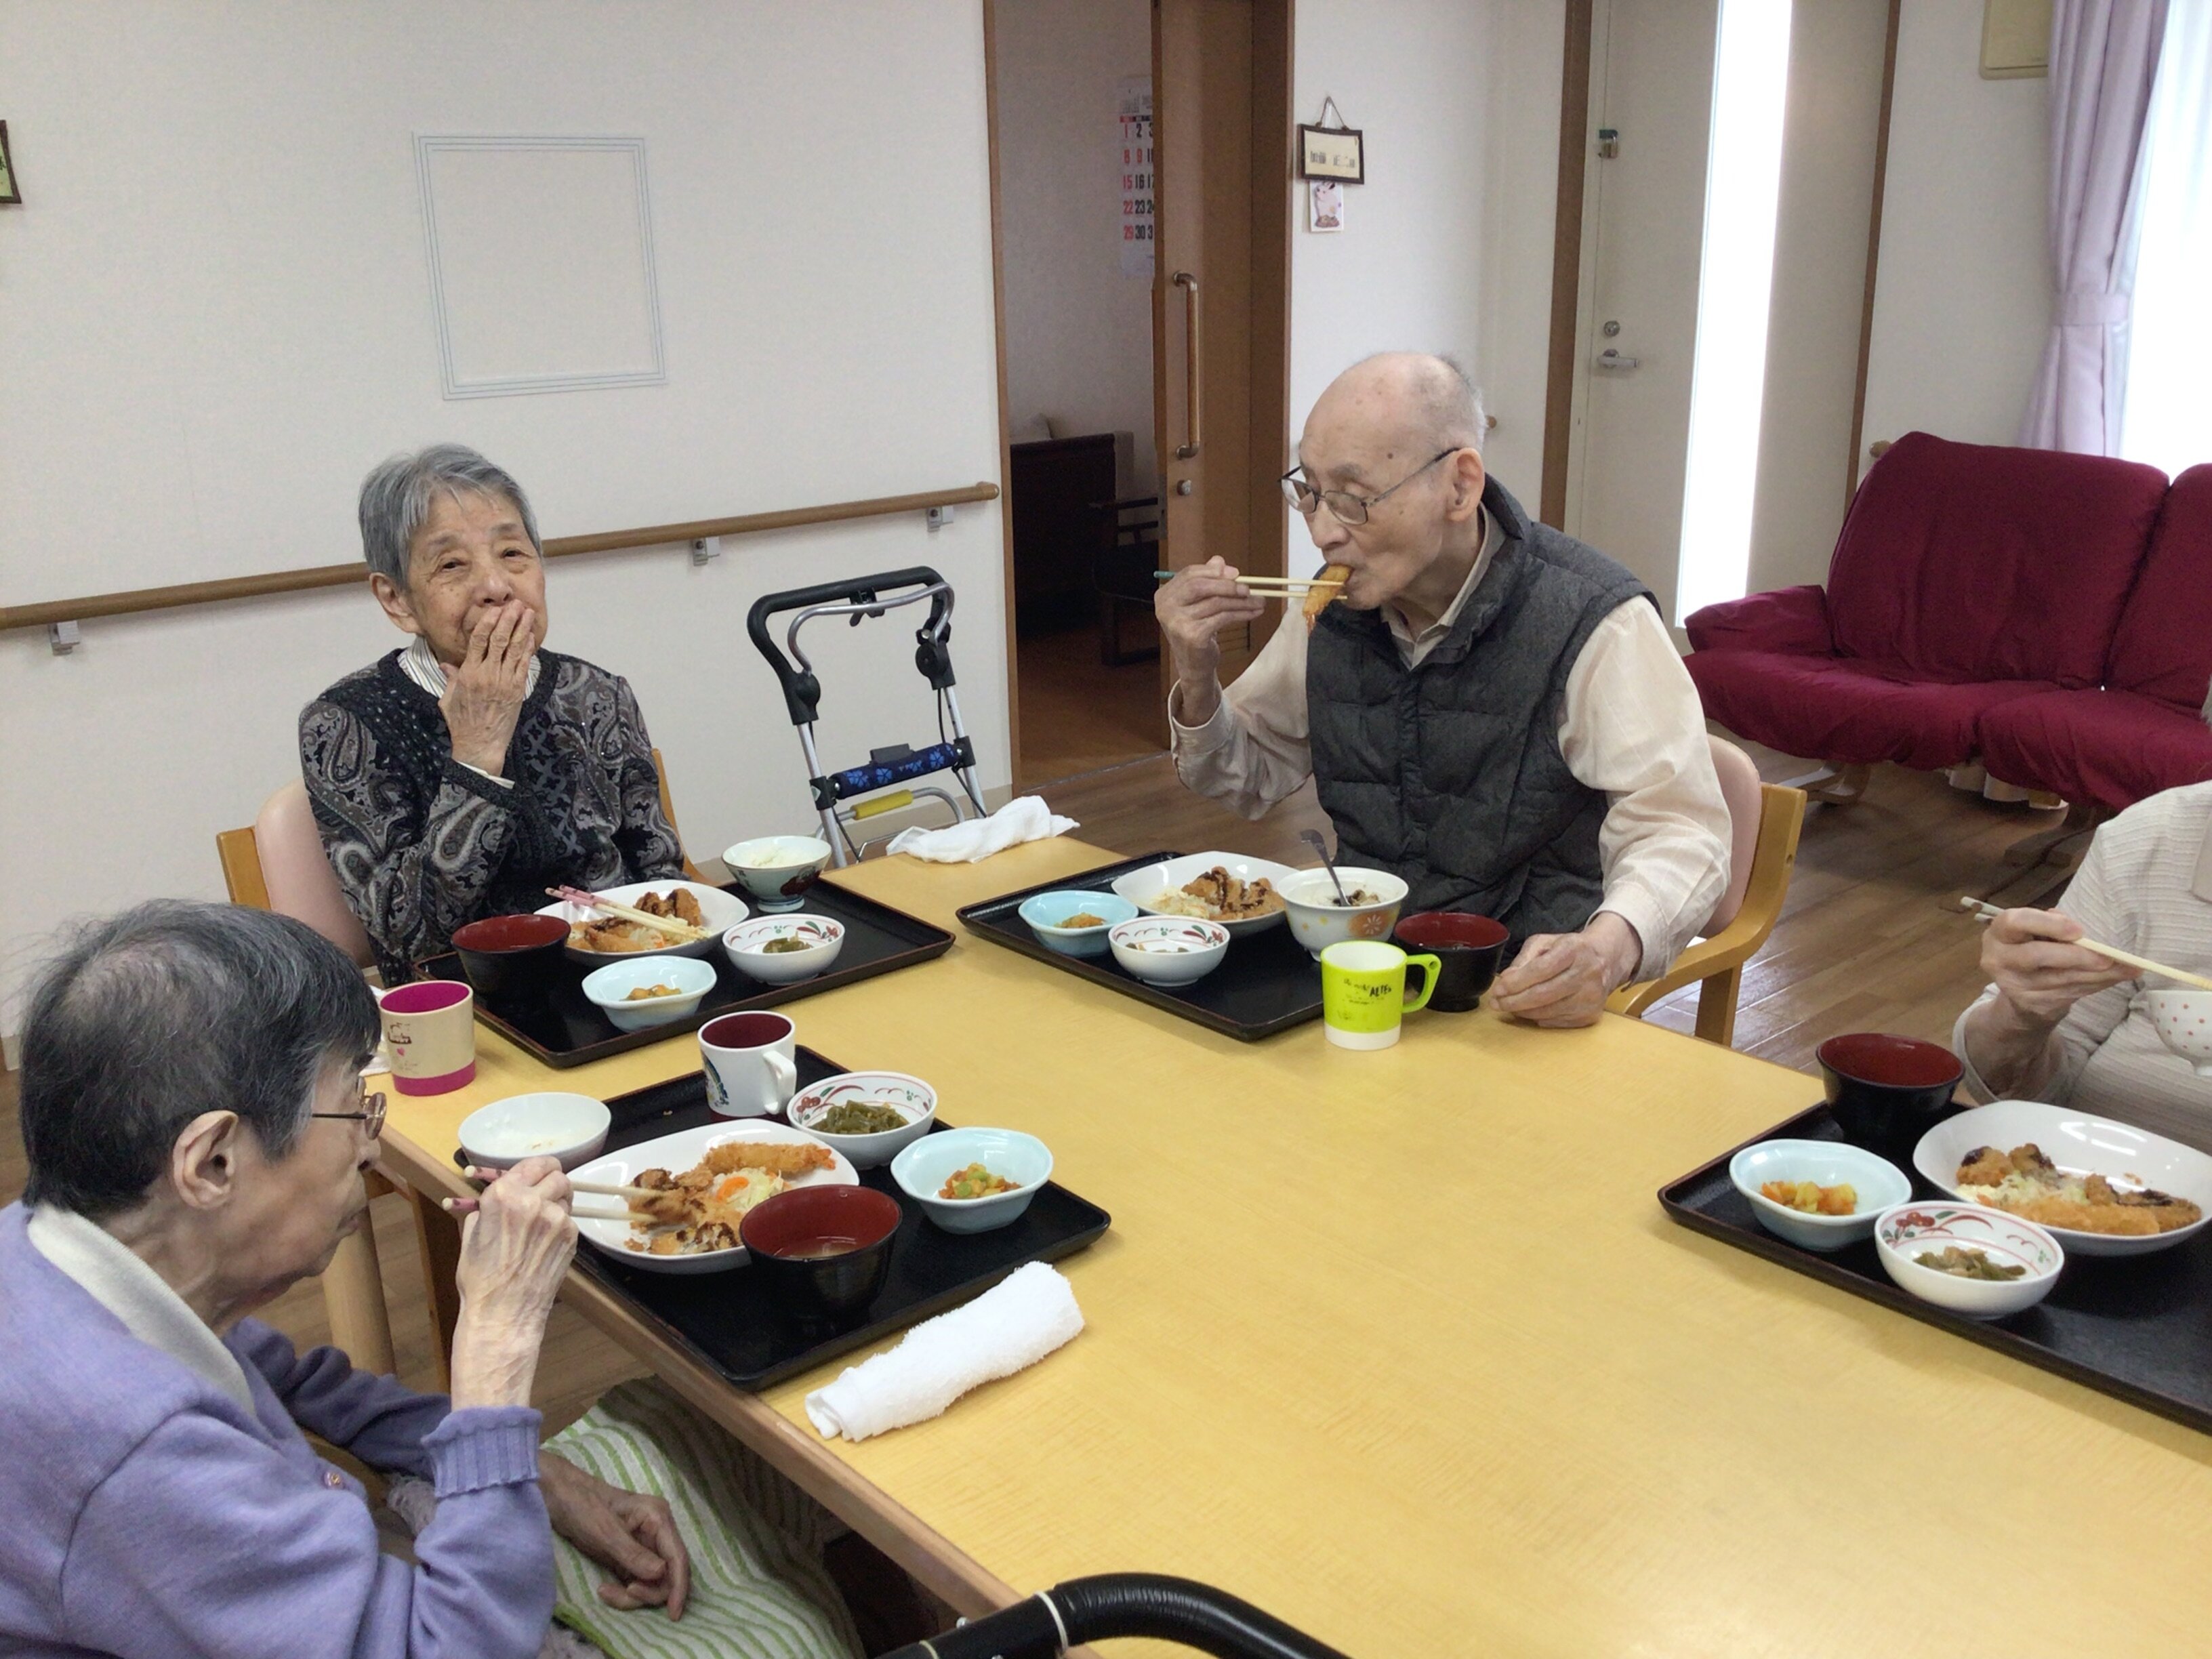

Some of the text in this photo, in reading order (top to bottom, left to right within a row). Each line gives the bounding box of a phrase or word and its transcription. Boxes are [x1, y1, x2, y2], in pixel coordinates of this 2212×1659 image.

[1136, 123, 1142, 138] 2
[1124, 149, 1130, 164] 8
[1123, 174, 1132, 189] 15
[1135, 173, 1145, 189] 16
[1123, 200, 1133, 214] 22
[1134, 199, 1145, 214] 23
[1134, 224, 1145, 239] 30
